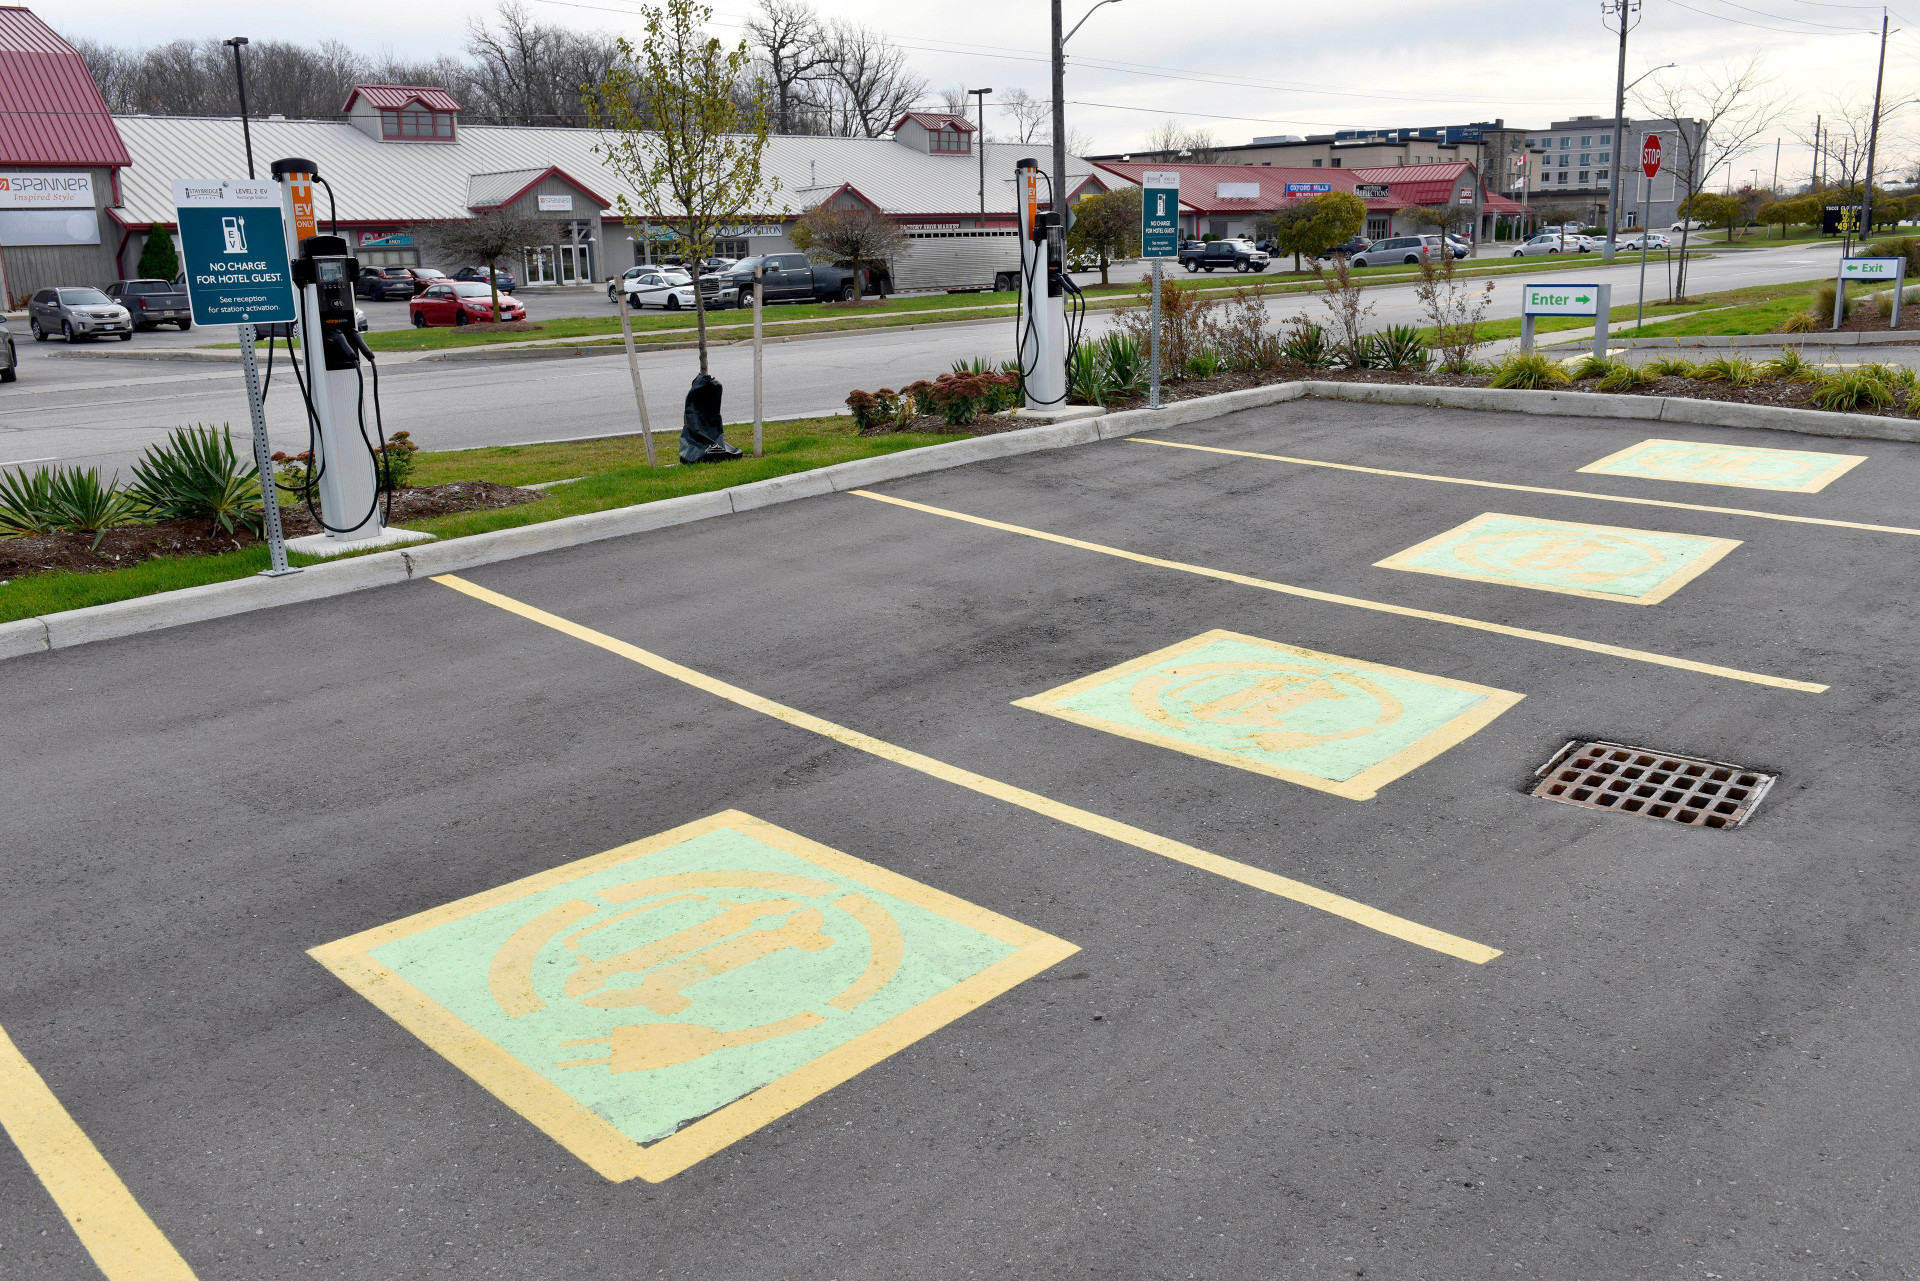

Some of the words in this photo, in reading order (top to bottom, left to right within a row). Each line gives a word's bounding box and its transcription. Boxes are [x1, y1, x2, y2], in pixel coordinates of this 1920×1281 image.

[1643, 149, 1661, 164] STOP
[11, 178, 88, 191] SPANNER
[1028, 187, 1036, 196] EV
[14, 193, 51, 202] Inspired
[53, 193, 75, 202] Style
[295, 204, 312, 215] EV
[209, 263, 226, 271] NO
[227, 261, 267, 271] CHARGE
[1862, 263, 1884, 273] Exit
[196, 275, 217, 284] FOR
[218, 274, 250, 283] HOTEL
[251, 273, 283, 282] GUEST.
[233, 295, 267, 303] reception
[1531, 292, 1570, 306] Enter
